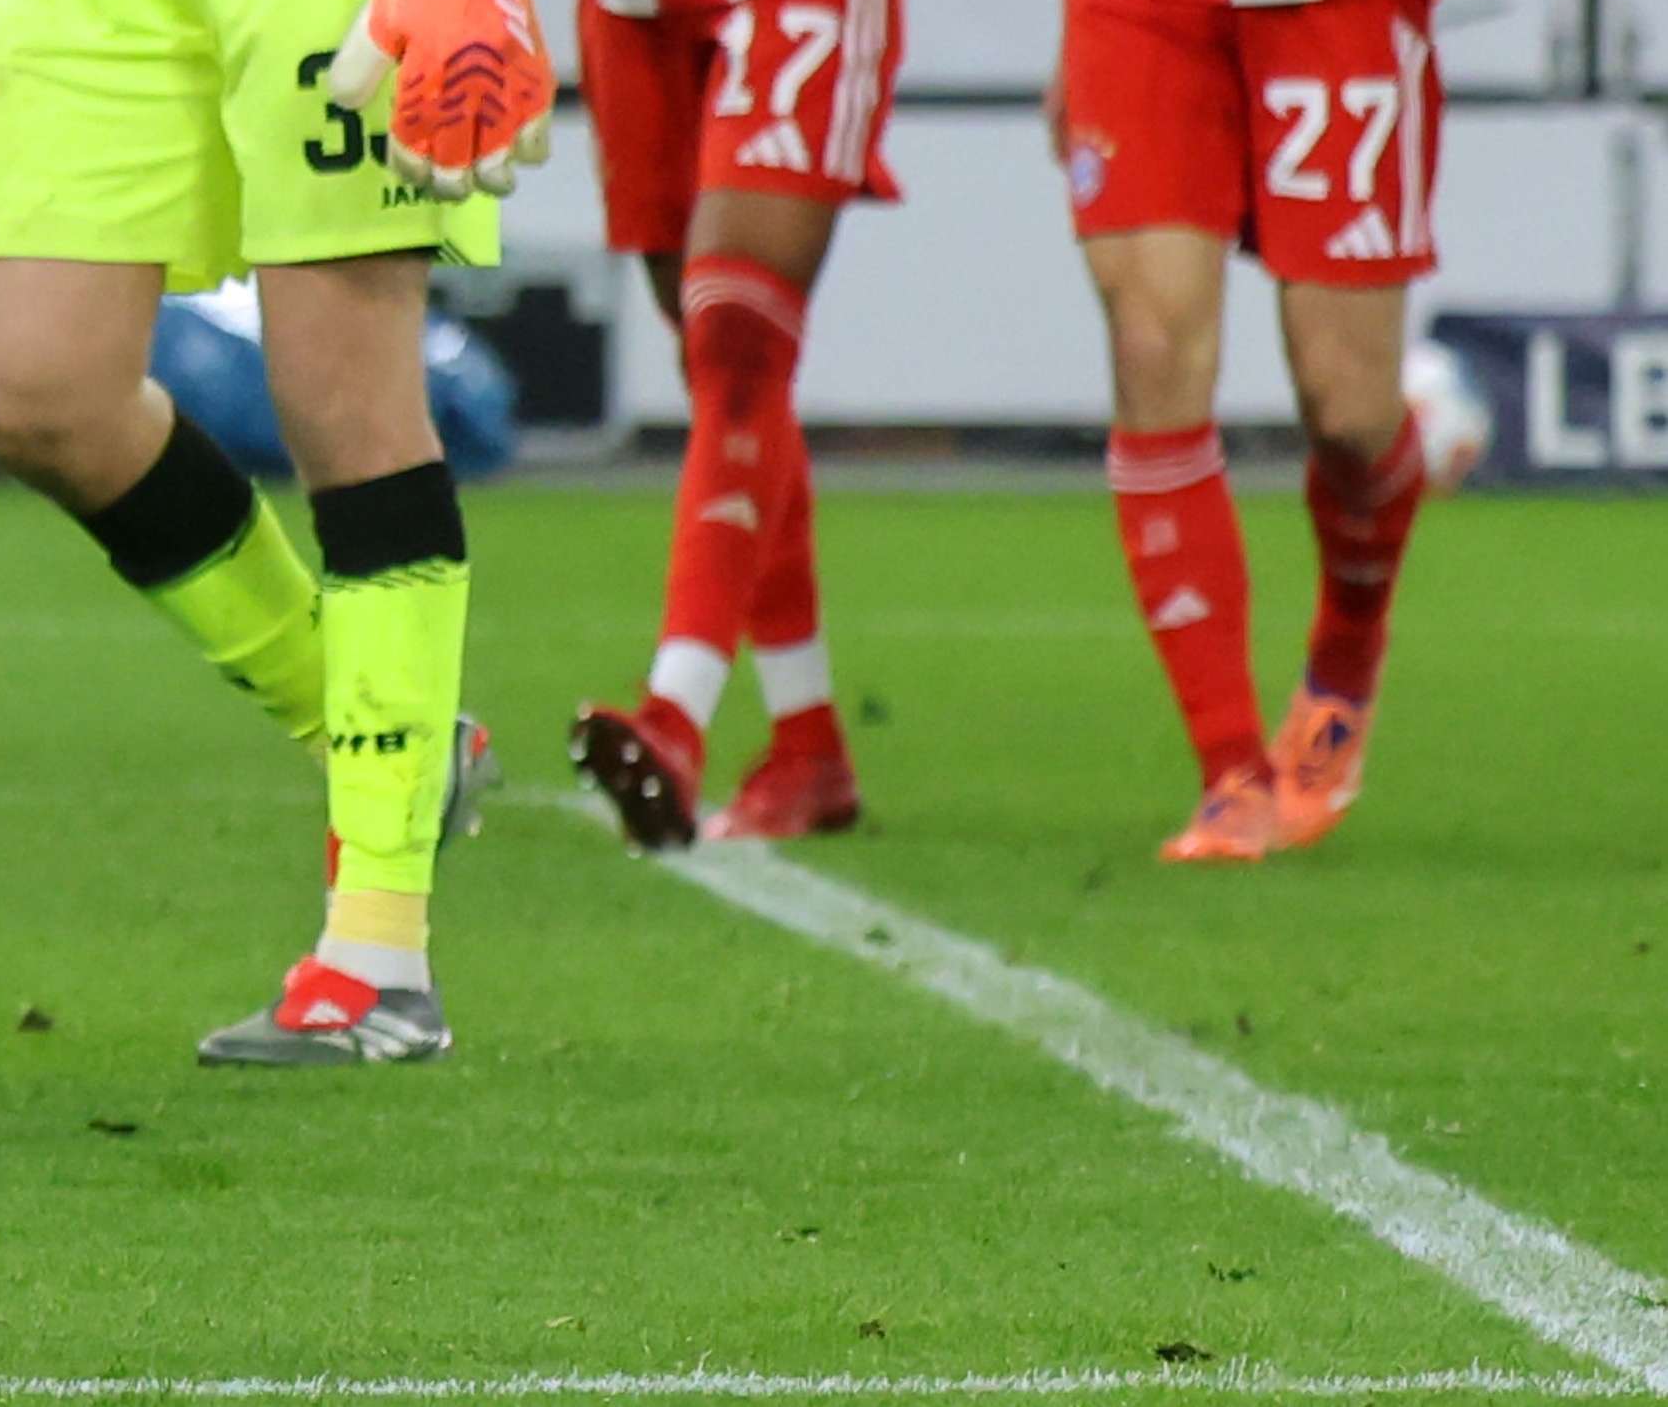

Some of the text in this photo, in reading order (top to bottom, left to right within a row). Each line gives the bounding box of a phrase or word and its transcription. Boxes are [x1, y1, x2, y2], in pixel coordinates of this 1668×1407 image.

[298, 49, 388, 174] 3
[715, 4, 840, 117] 17
[1263, 78, 1399, 202] 27
